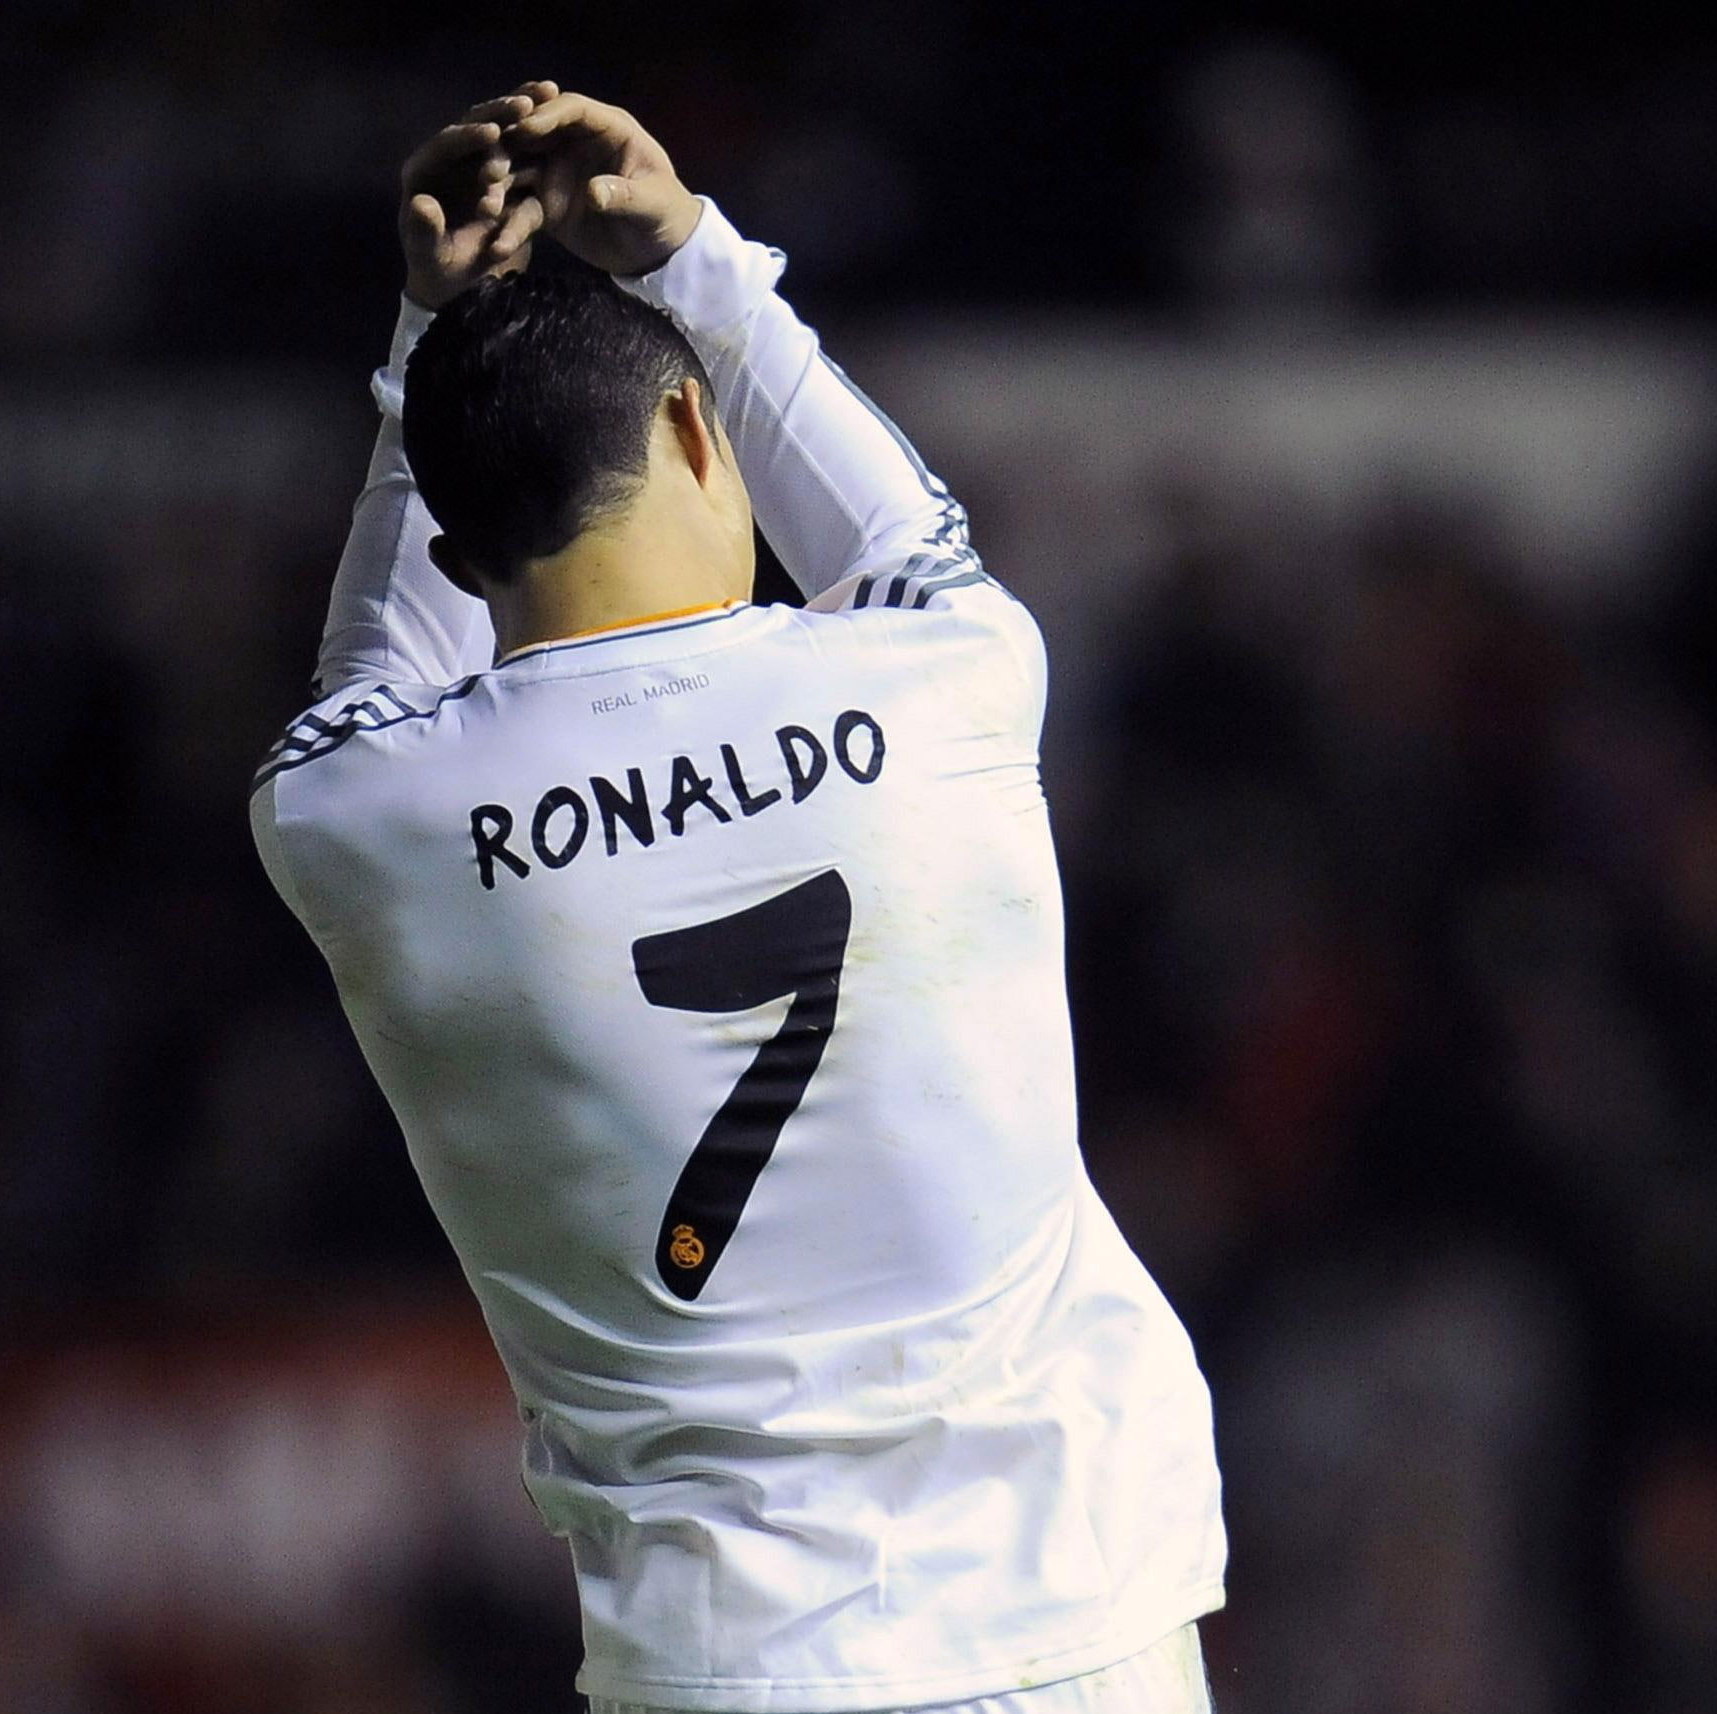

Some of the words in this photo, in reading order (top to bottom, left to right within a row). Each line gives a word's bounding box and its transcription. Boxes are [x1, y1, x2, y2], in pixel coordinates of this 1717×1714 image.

[591, 692, 637, 715] REAL
[643, 673, 710, 702] MADRID
[470, 709, 886, 891] RONALDO
[631, 868, 853, 1302] 7
